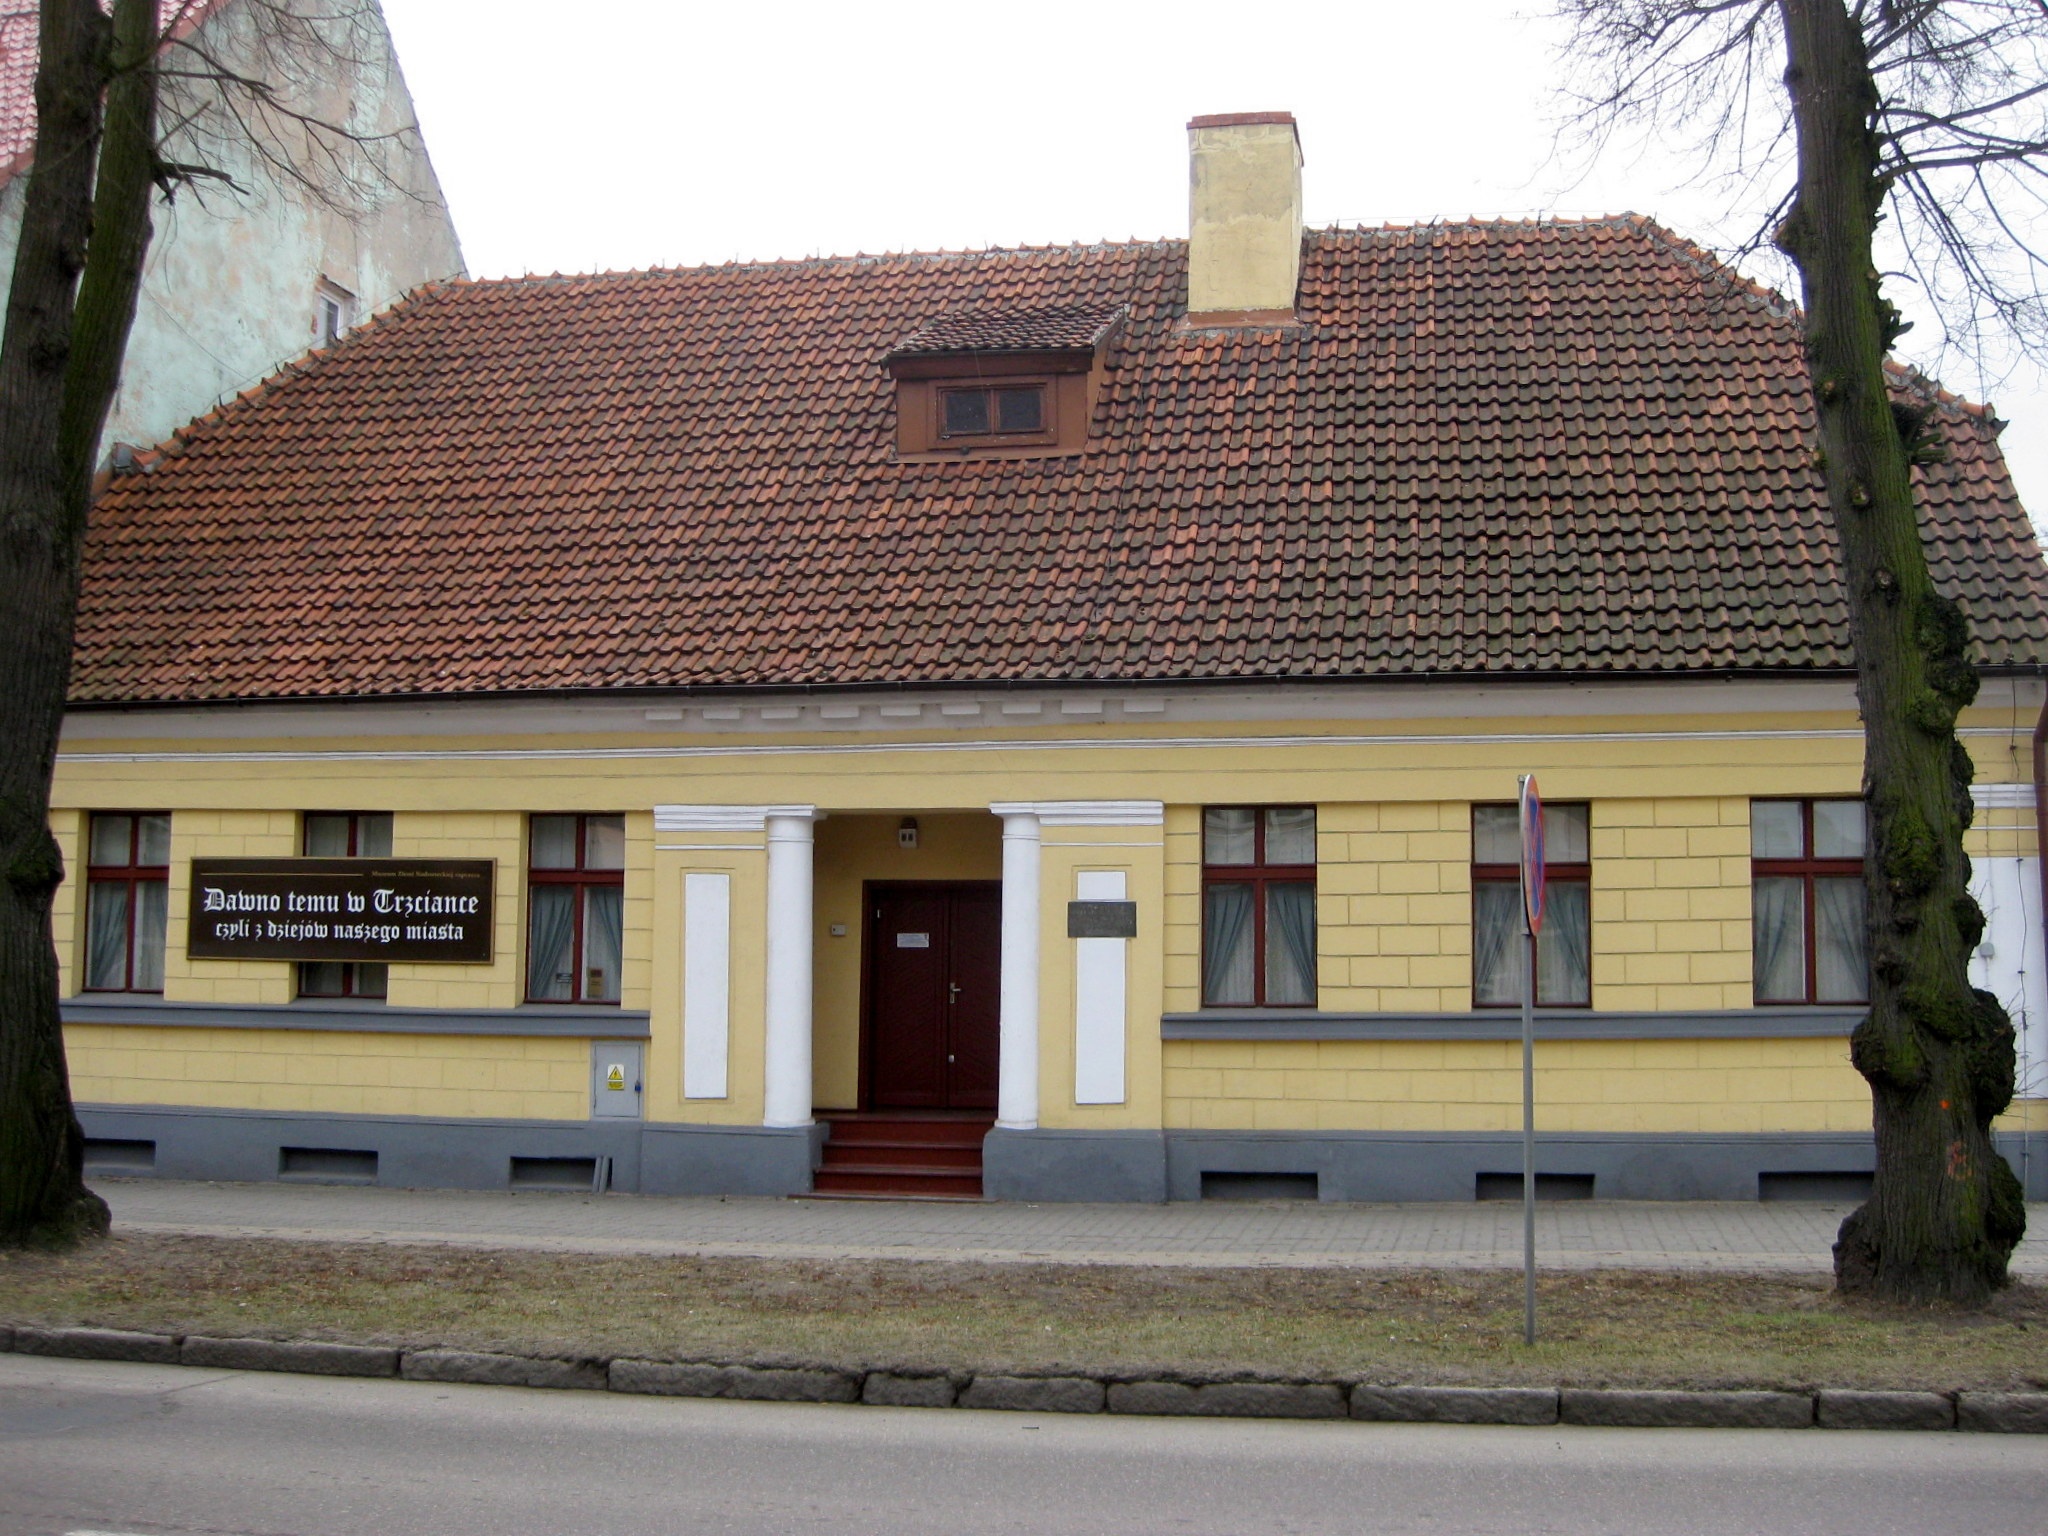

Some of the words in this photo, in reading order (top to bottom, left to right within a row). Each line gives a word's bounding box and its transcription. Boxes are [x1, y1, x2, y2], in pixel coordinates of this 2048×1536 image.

[204, 887, 280, 912] Dawno
[288, 890, 339, 912] temu
[347, 890, 365, 913] w
[372, 888, 479, 919] Trzciance
[215, 918, 250, 940] czyli
[255, 923, 262, 941] z
[267, 919, 328, 941] dziejów
[334, 922, 400, 943] naszego
[406, 920, 464, 940] miasta
